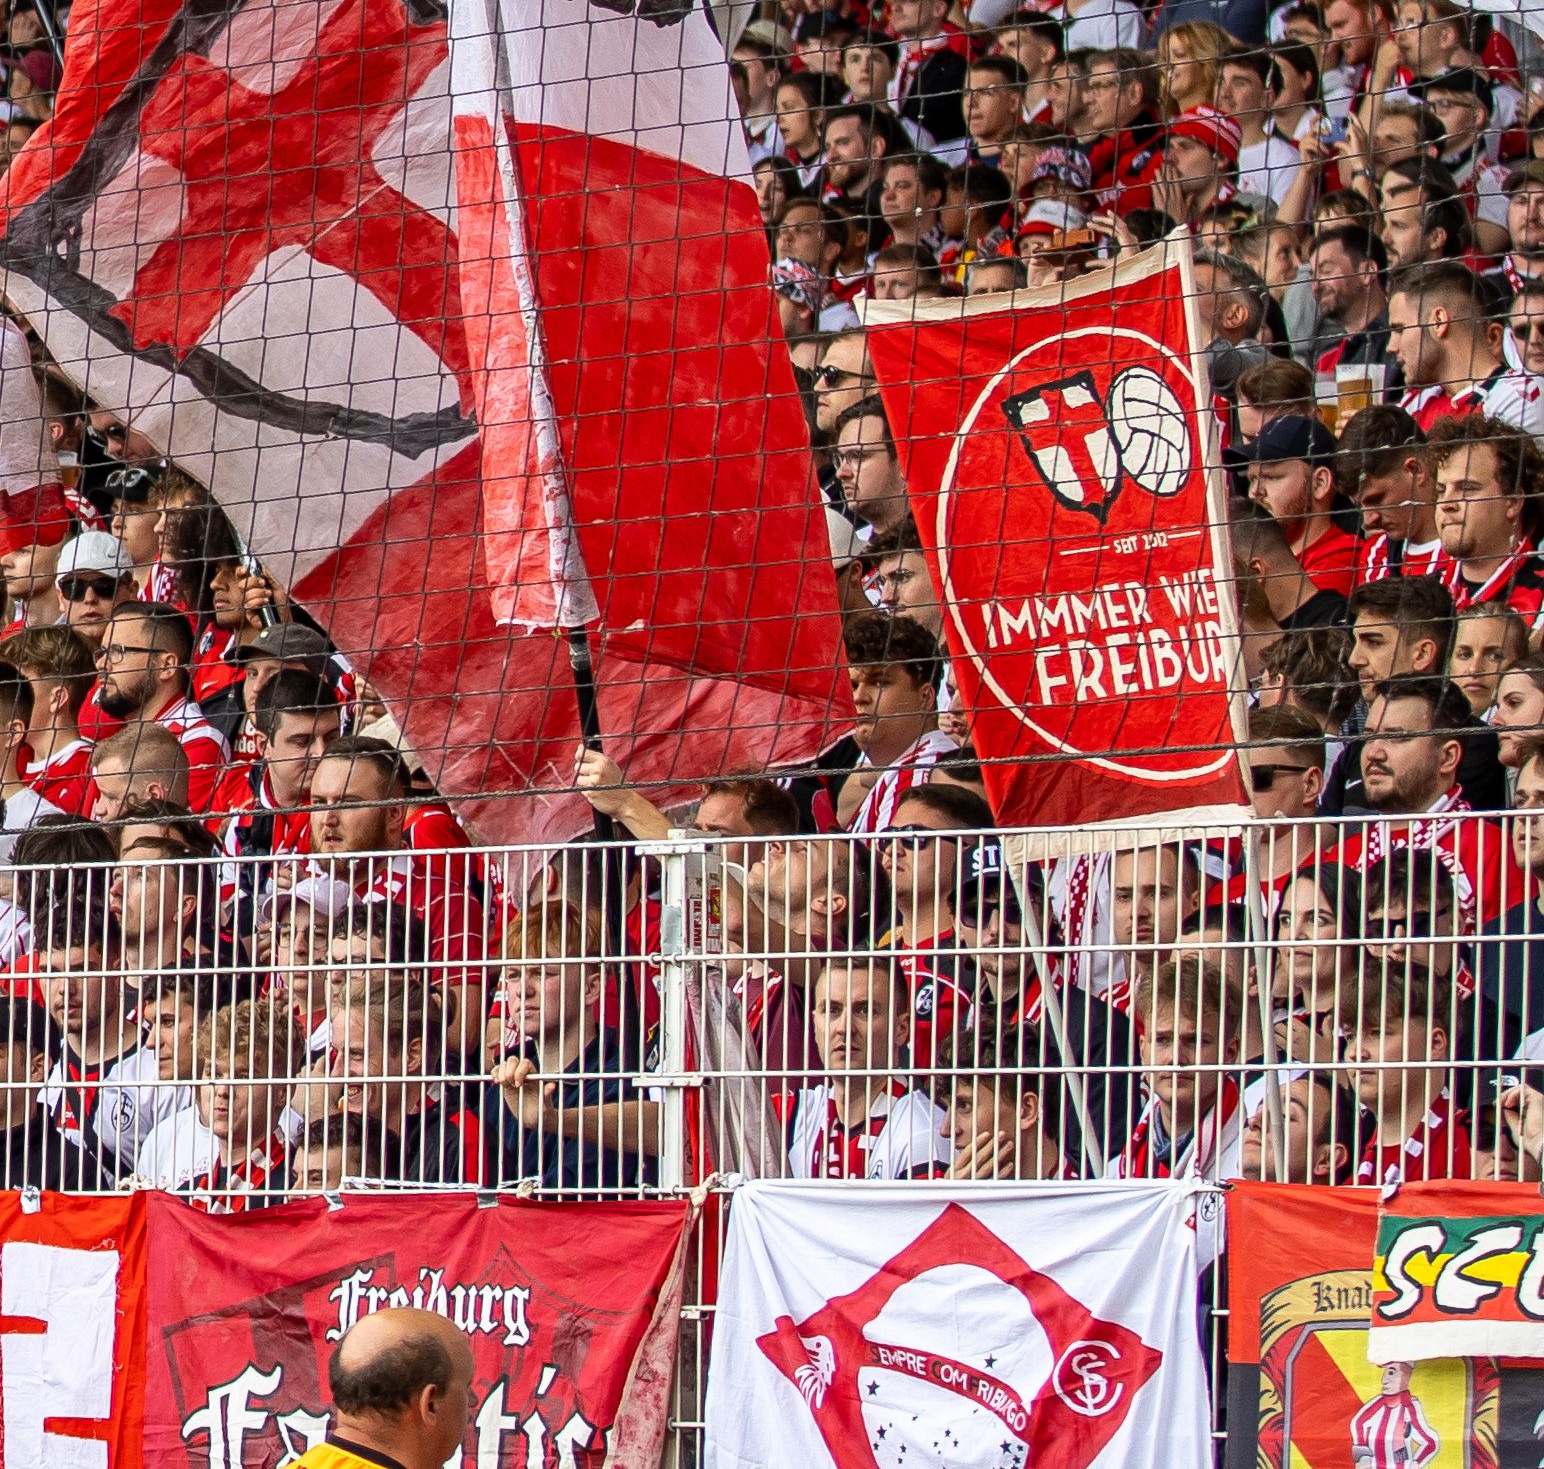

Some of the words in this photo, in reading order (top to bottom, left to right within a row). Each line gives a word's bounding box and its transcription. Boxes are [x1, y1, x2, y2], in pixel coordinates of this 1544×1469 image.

[1113, 536, 1140, 556] SEIT
[1159, 566, 1218, 621] WIE
[869, 1341, 929, 1378] SEMPRE
[930, 1358, 969, 1397] COM
